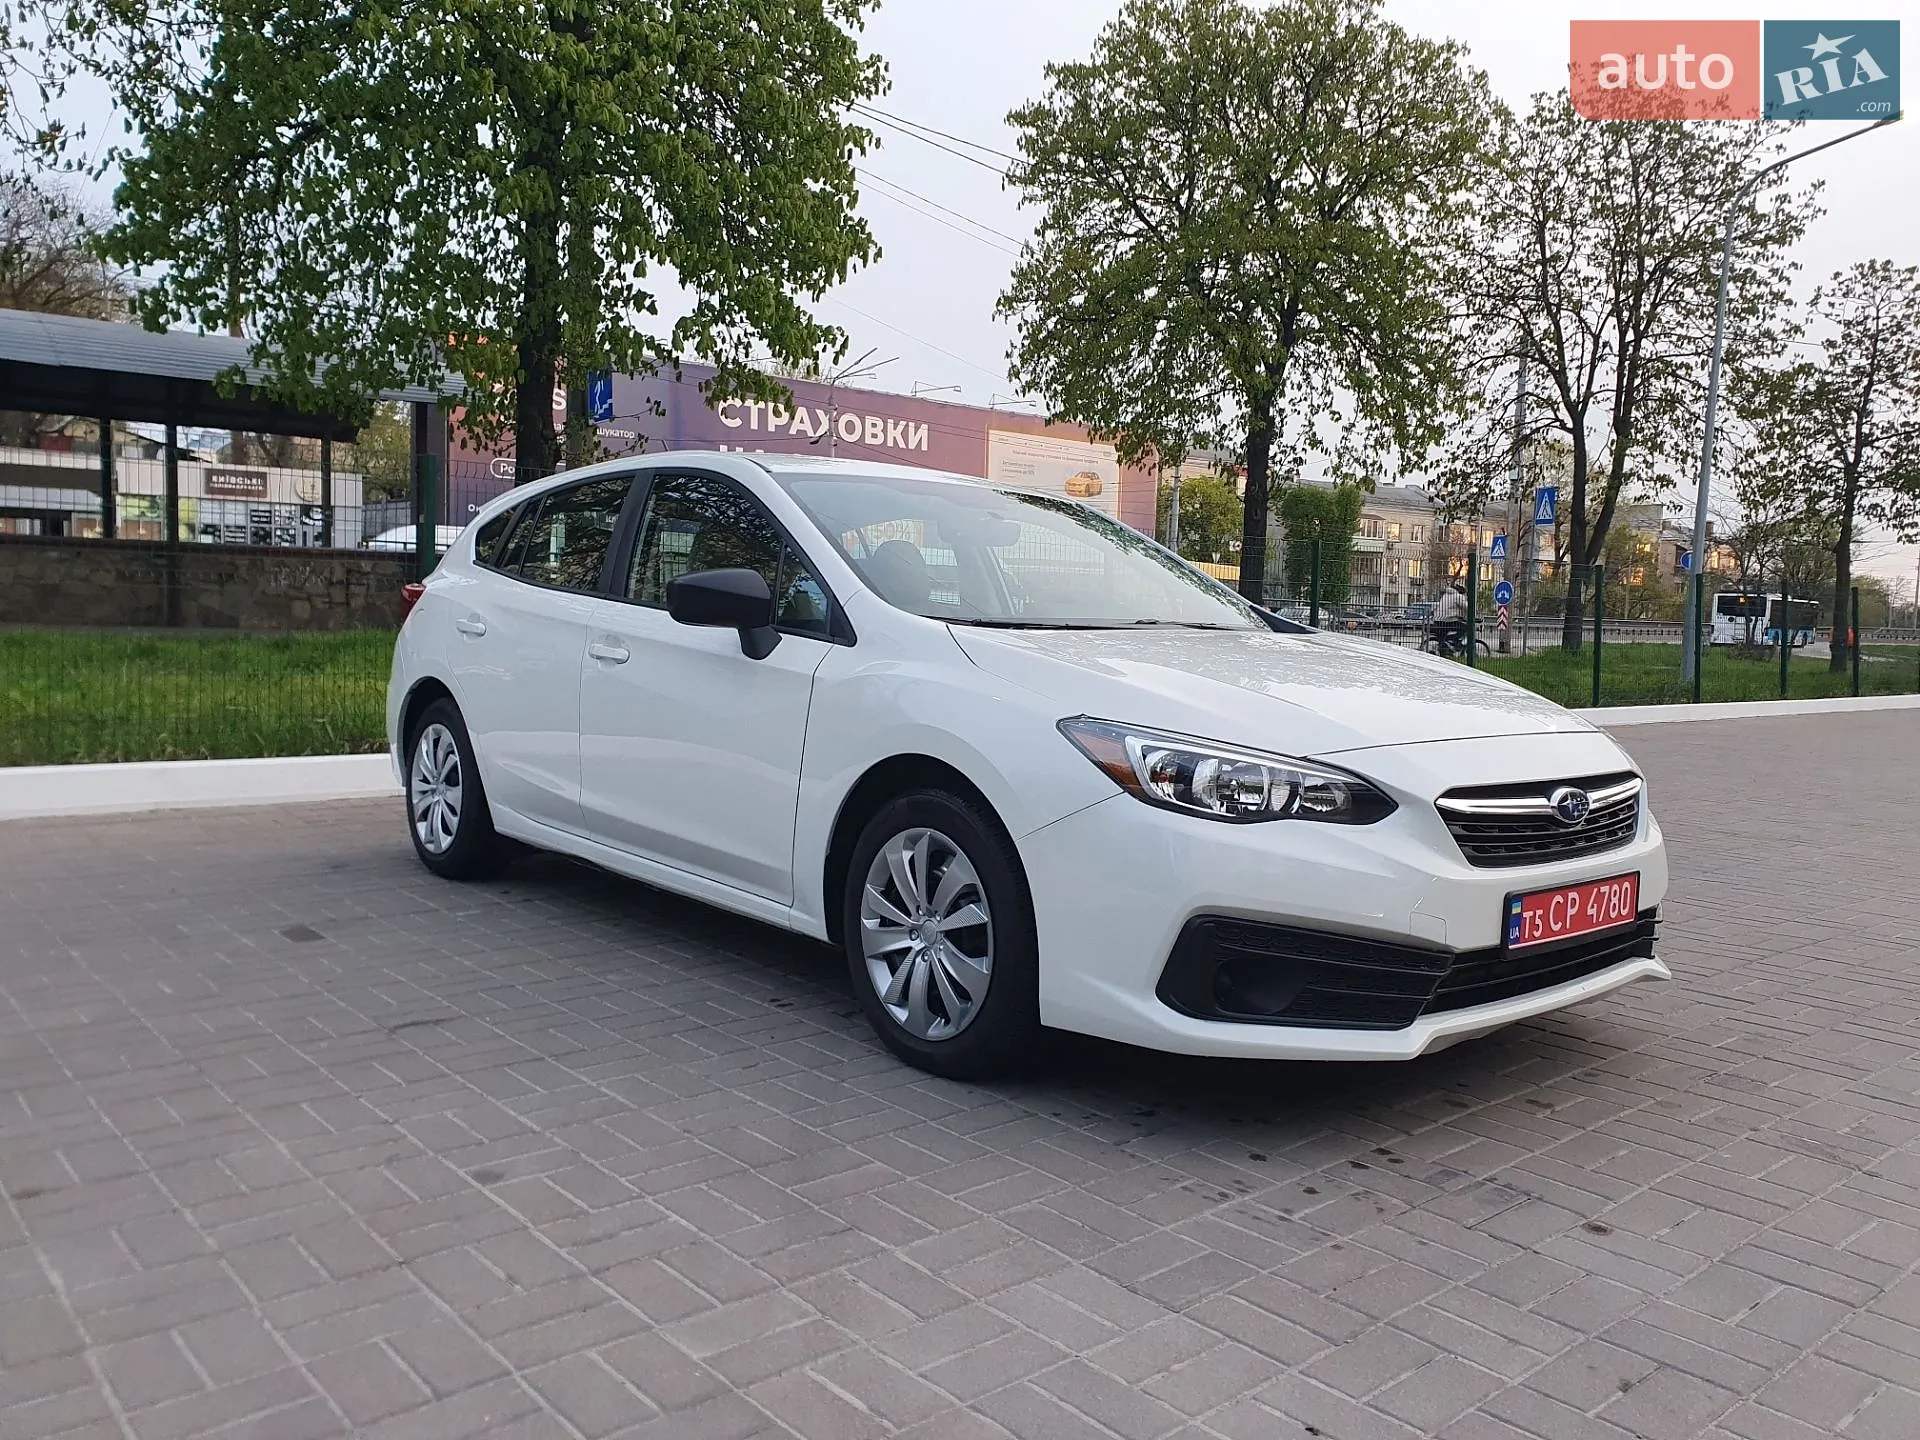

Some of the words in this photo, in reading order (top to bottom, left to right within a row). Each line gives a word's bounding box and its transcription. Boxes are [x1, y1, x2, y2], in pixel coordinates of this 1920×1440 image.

[718, 395, 929, 452] СТРАХОВКИ
[1509, 926, 1520, 939] UA
[1522, 909, 1544, 939] T5
[1549, 891, 1580, 932] CP
[1586, 881, 1631, 924] 4780
